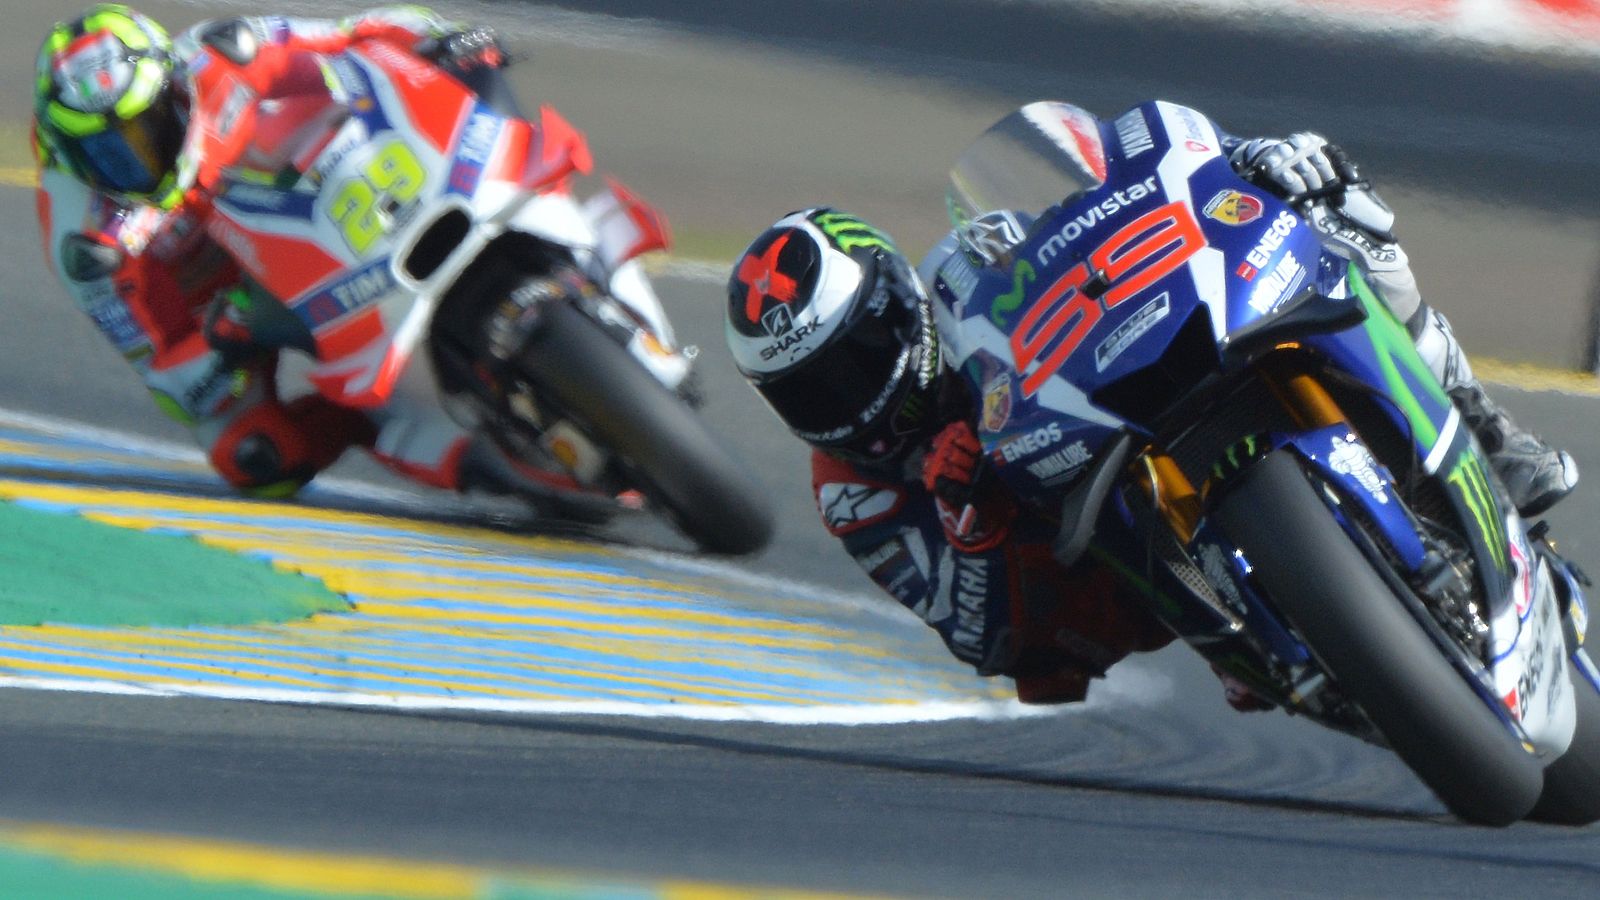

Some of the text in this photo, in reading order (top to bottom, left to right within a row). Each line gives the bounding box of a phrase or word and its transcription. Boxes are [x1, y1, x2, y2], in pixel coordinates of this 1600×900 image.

[331, 140, 426, 255] 29
[1036, 176, 1158, 267] movistar
[1246, 210, 1298, 270] ENEOS
[331, 265, 392, 310] TIM
[1009, 200, 1209, 400] 99
[759, 315, 825, 362] SHARK
[1001, 421, 1064, 463] ENEOS
